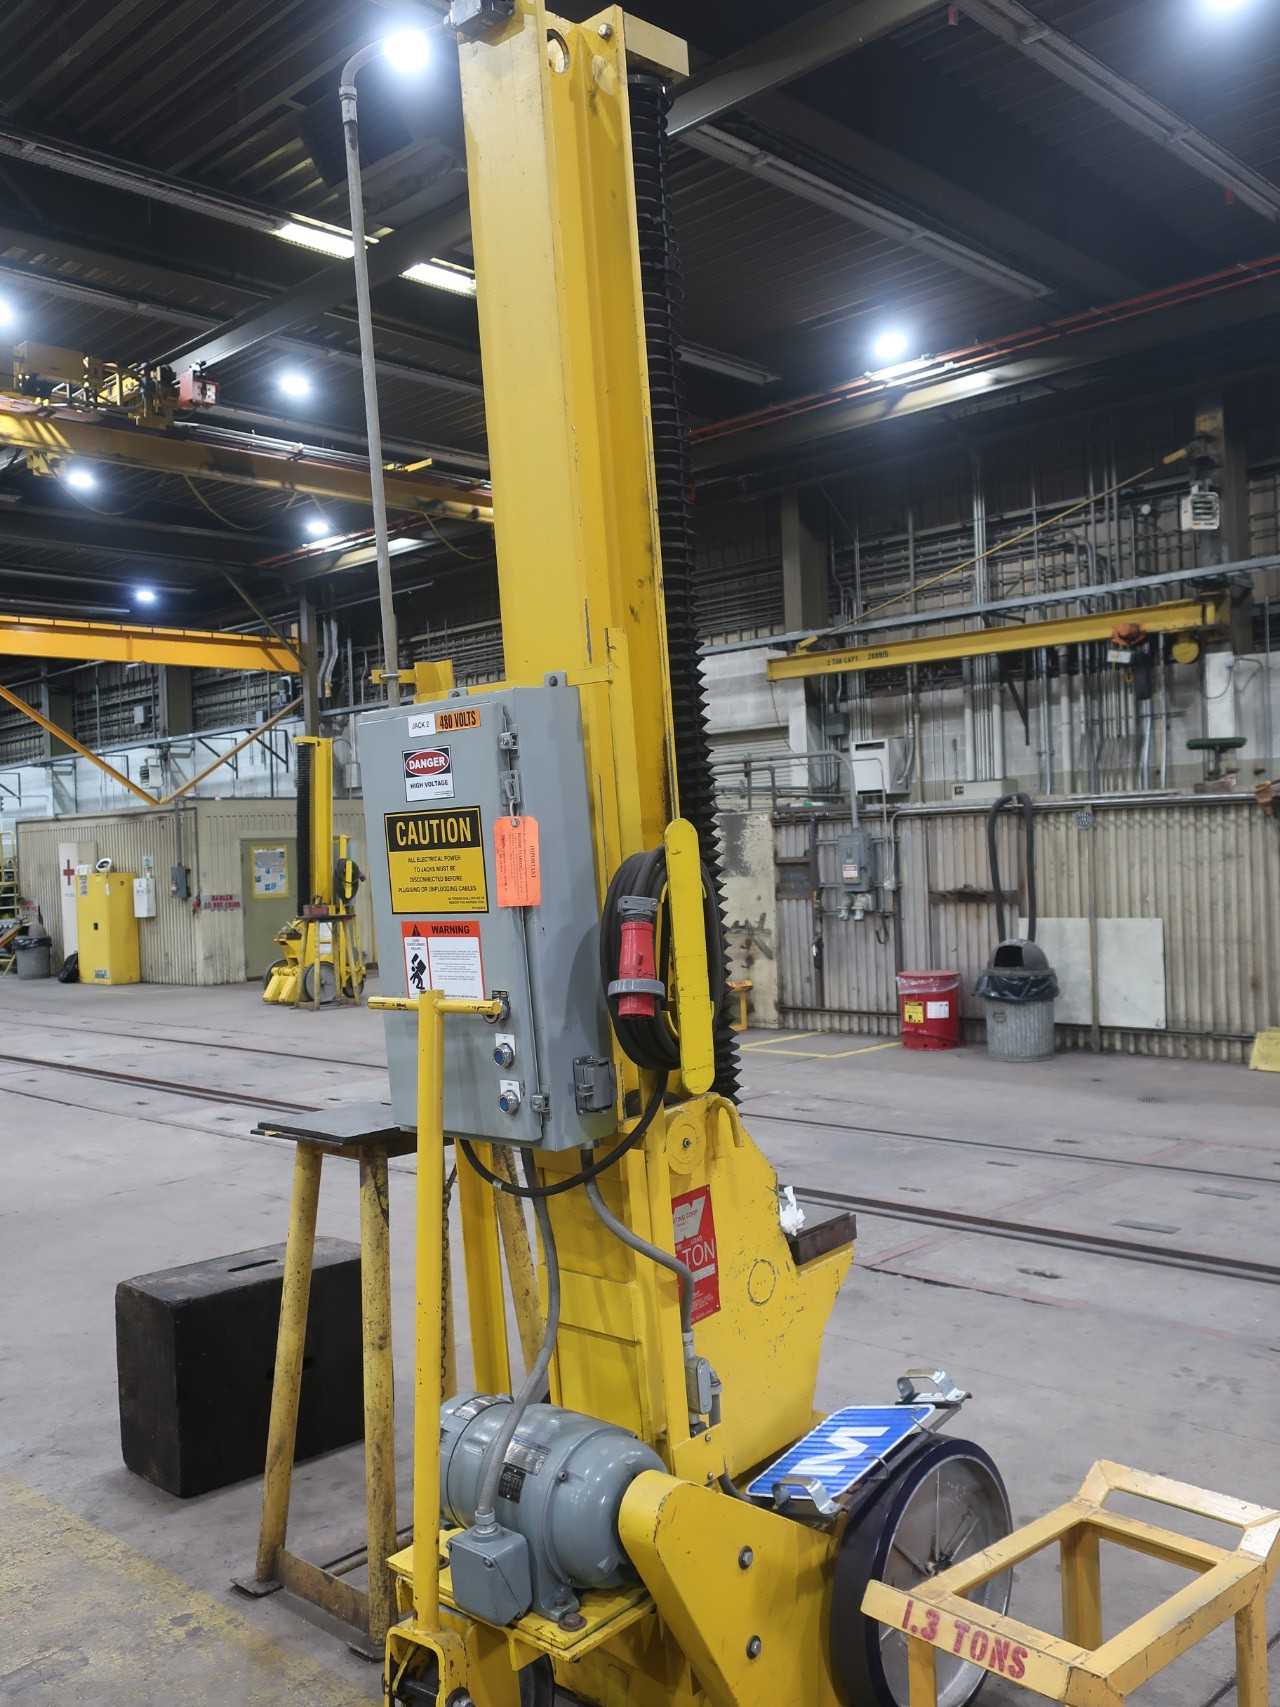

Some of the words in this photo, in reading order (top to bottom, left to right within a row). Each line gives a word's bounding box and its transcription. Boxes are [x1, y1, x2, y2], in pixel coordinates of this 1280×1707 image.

[440, 714, 453, 730] 480
[454, 710, 477, 728] VOLTS
[408, 756, 446, 770] DANGER
[424, 779, 449, 788] VOLTAGE
[395, 816, 472, 847] CAUTION
[431, 925, 471, 935] WARNING
[682, 1238, 716, 1273] TON
[788, 1426, 891, 1477] M
[901, 1599, 941, 1641] 1.3
[952, 1618, 1029, 1680] TONS
